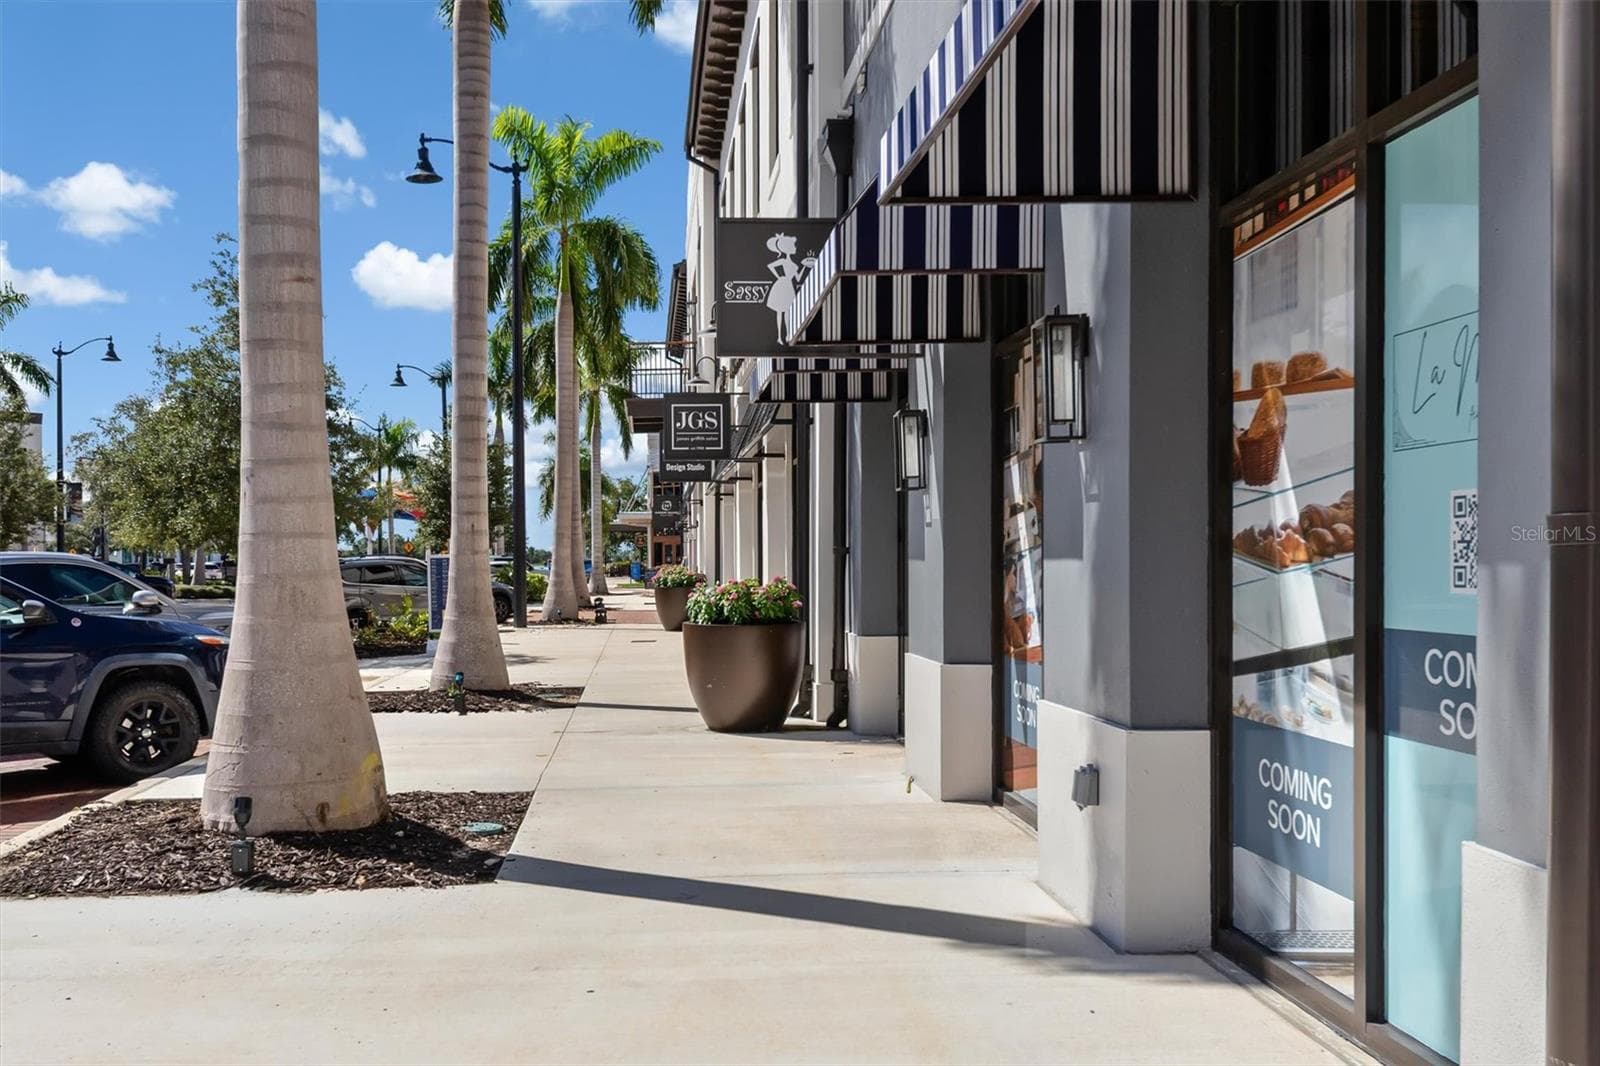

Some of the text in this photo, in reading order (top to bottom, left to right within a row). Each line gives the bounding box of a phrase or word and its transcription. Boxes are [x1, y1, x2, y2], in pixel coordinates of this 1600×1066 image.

[724, 281, 769, 303] Sassy
[1412, 331, 1446, 414] La
[676, 411, 718, 429] JGS
[665, 463, 705, 472] Design Studio
[1439, 698, 1477, 739] SO
[1258, 758, 1332, 810] COMING
[1267, 799, 1320, 849] SOON
